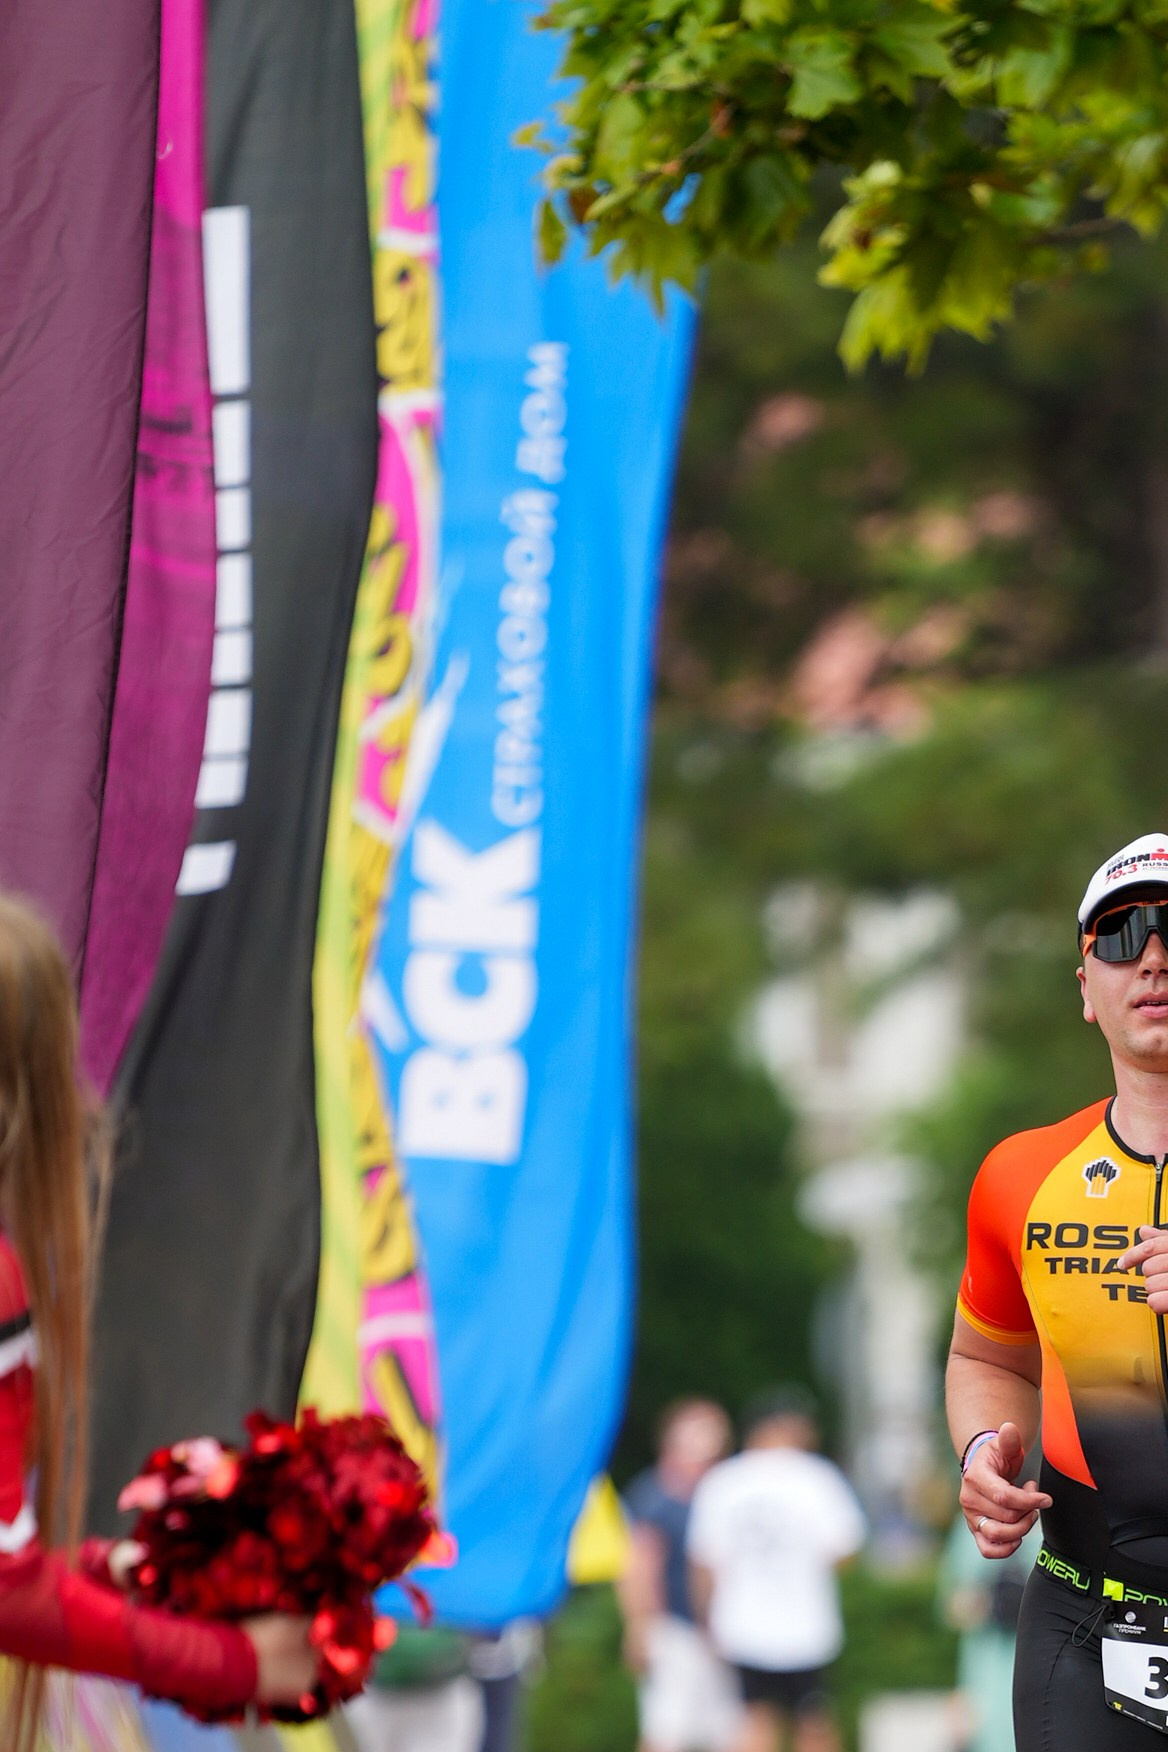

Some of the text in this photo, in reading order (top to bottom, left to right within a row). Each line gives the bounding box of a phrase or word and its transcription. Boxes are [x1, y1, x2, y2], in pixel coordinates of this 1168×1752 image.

[491, 342, 571, 828] СТРАХОВОЙ ДОМ
[1105, 864, 1138, 885] 70.3
[399, 819, 543, 1165] ВСК
[1101, 1283, 1149, 1304] TE
[1036, 1549, 1090, 1590] OWERU
